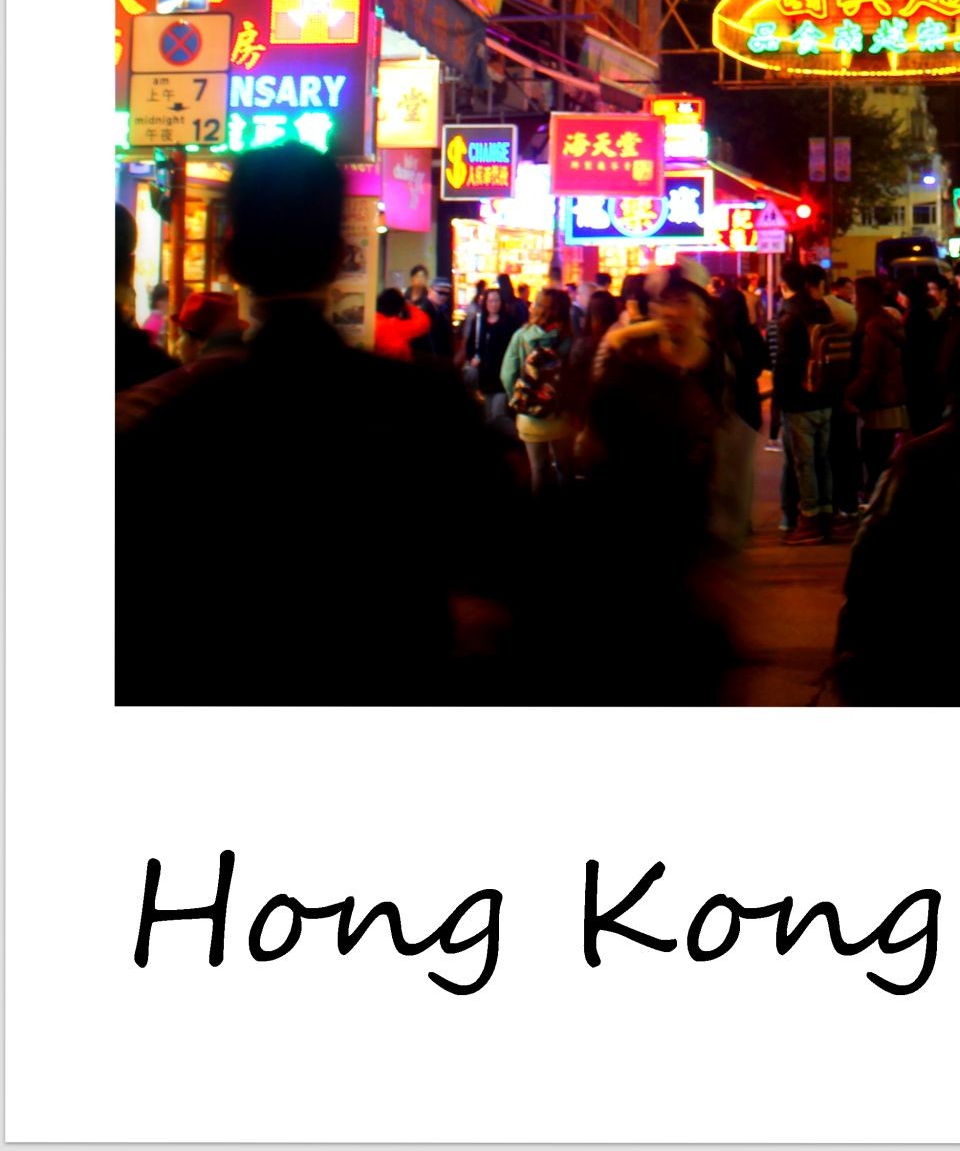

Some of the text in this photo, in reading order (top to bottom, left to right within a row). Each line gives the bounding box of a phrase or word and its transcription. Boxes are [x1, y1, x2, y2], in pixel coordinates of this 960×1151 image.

[193, 78, 208, 102] 7
[134, 116, 185, 126] midnight
[192, 118, 220, 142] 12
